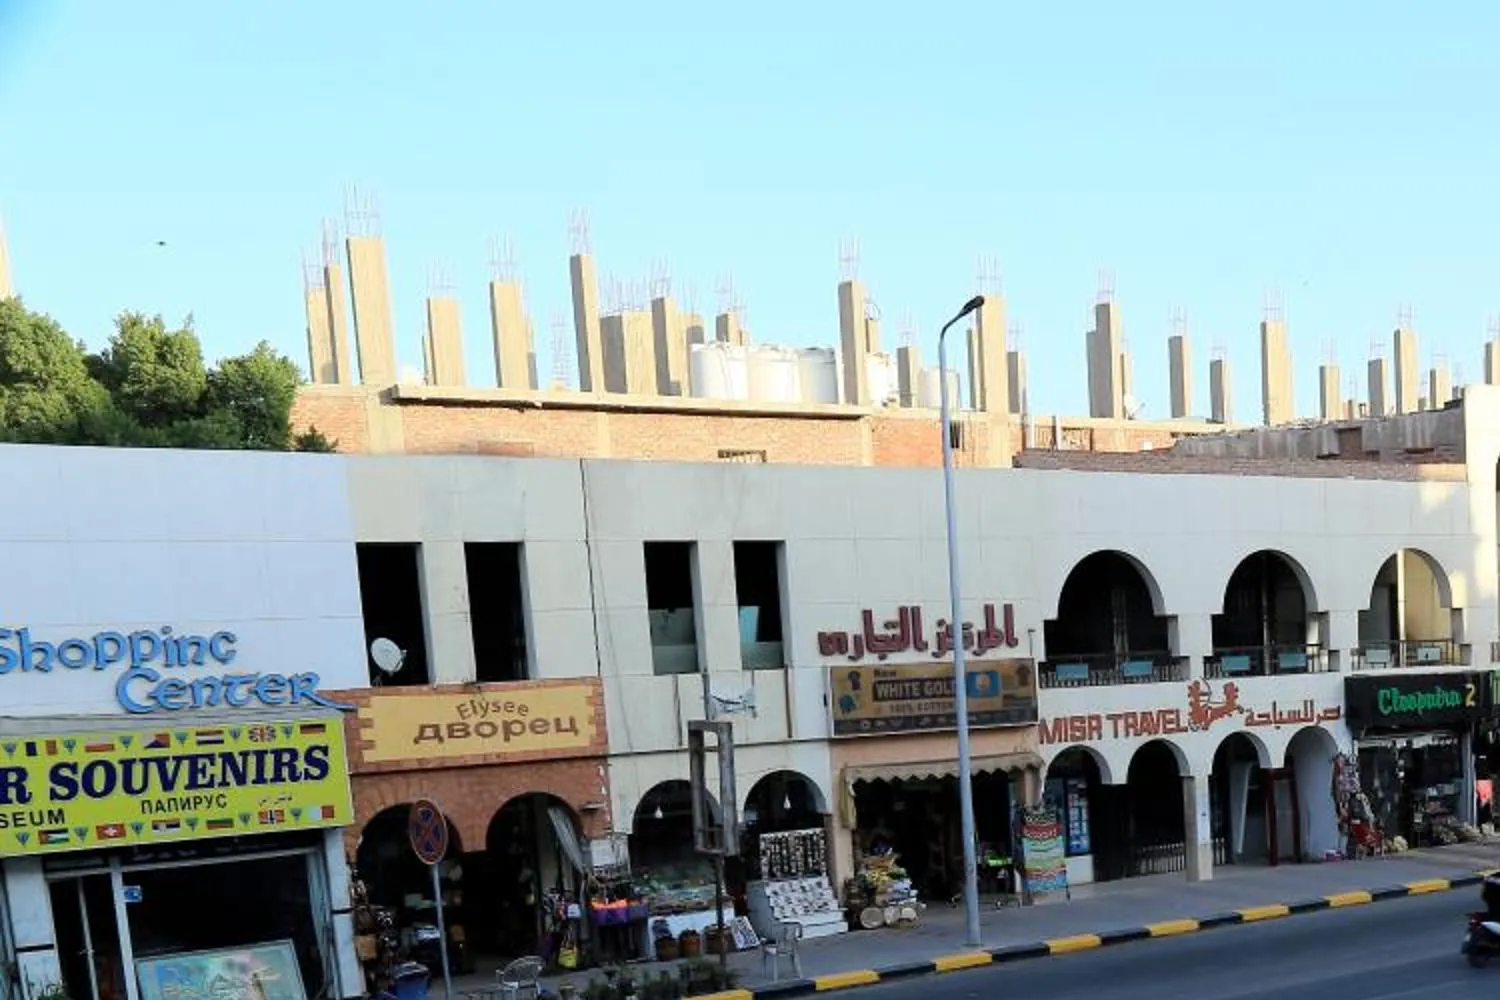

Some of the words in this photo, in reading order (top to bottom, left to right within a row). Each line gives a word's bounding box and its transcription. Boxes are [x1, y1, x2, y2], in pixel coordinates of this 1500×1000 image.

[875, 681, 920, 699] WHITE
[1465, 683, 1476, 707] 2
[456, 699, 529, 720] Elysee
[1038, 714, 1103, 745] MISR
[1106, 708, 1189, 739] TRAVEL
[49, 744, 330, 802] SOUVENIRS
[140, 793, 228, 815] ПАПИРУС
